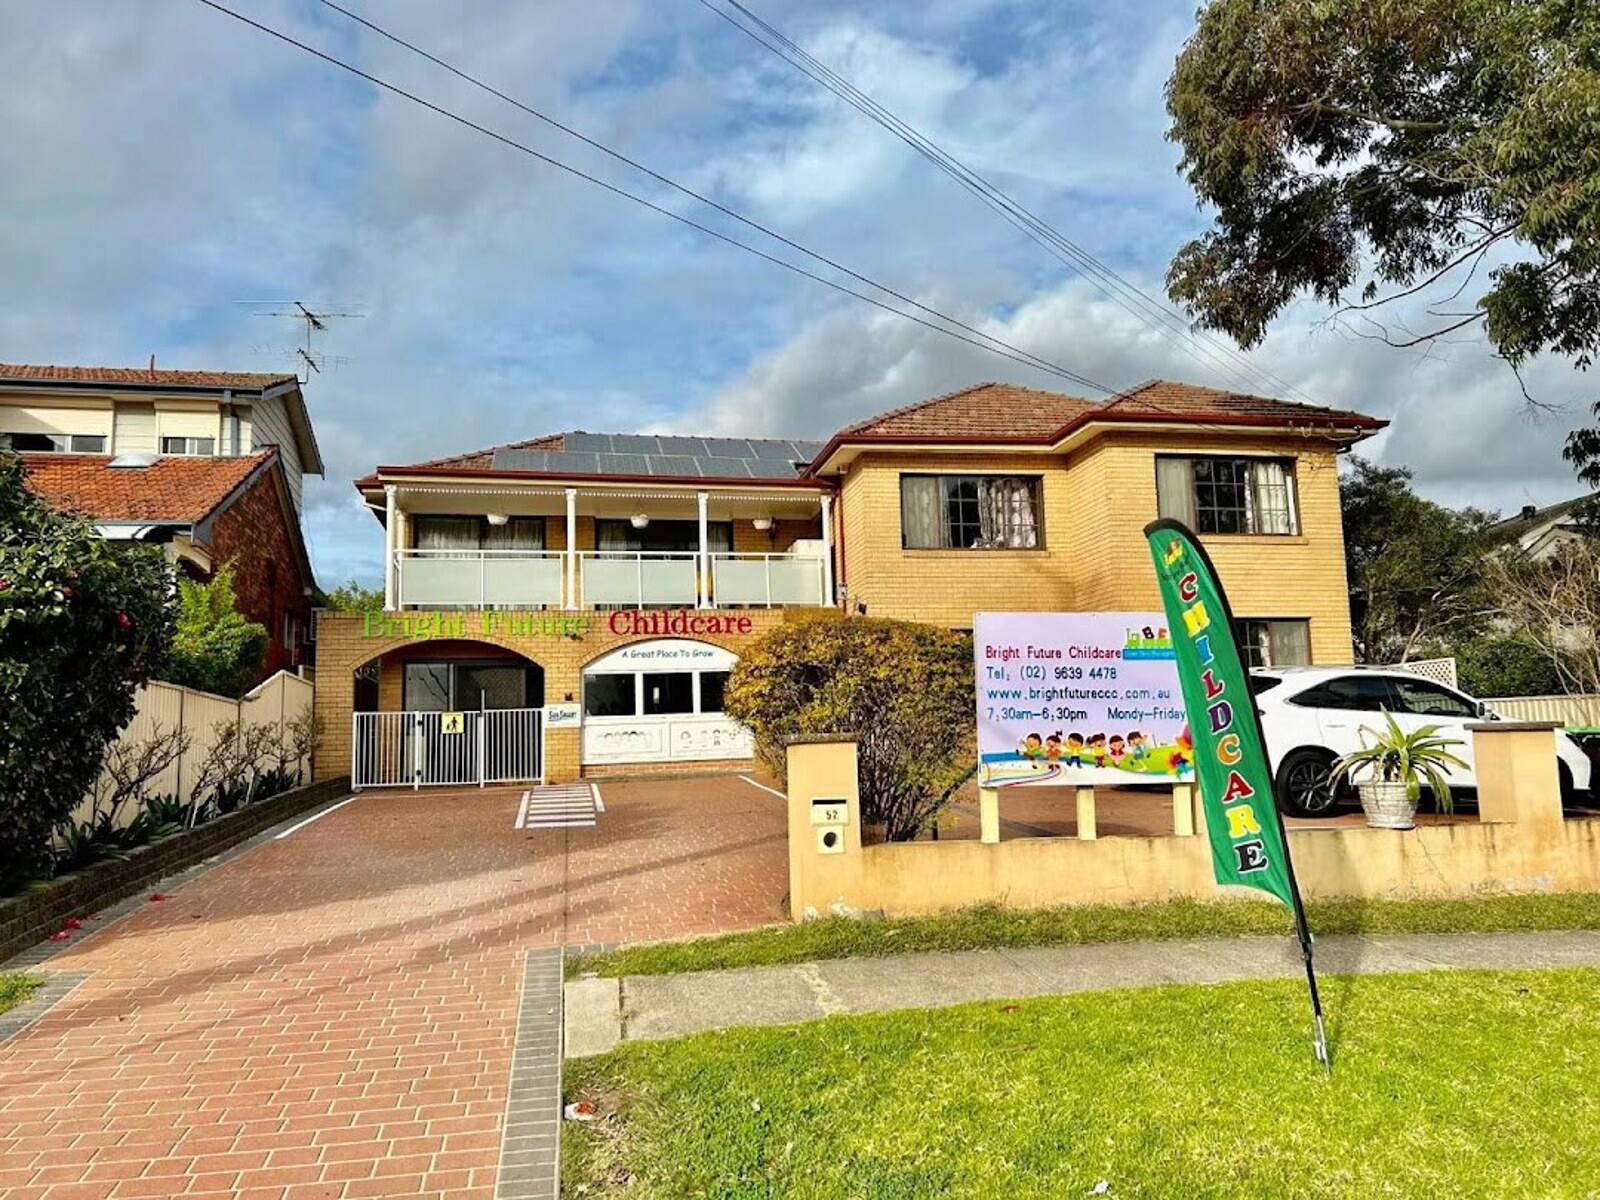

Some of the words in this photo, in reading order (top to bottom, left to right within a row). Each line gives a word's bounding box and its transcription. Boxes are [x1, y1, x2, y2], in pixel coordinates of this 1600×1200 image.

[363, 608, 466, 640] Bright
[482, 608, 588, 637] Future
[608, 607, 752, 636] Childcare
[622, 650, 628, 658] A
[630, 649, 655, 659] Great
[656, 649, 678, 658] Place
[680, 649, 691, 658] To
[692, 649, 714, 657] Grow
[985, 645, 1020, 661] Bright
[1027, 645, 1062, 659] Future
[1068, 645, 1121, 659] Childcare
[1020, 665, 1047, 681] (02)
[1054, 666, 1083, 680] 9639
[1089, 667, 1117, 680] 4478
[987, 686, 1170, 702] www.brightfutureccc.com.au
[1178, 572, 1267, 872] CHILDCARE
[826, 809, 839, 820] 52
